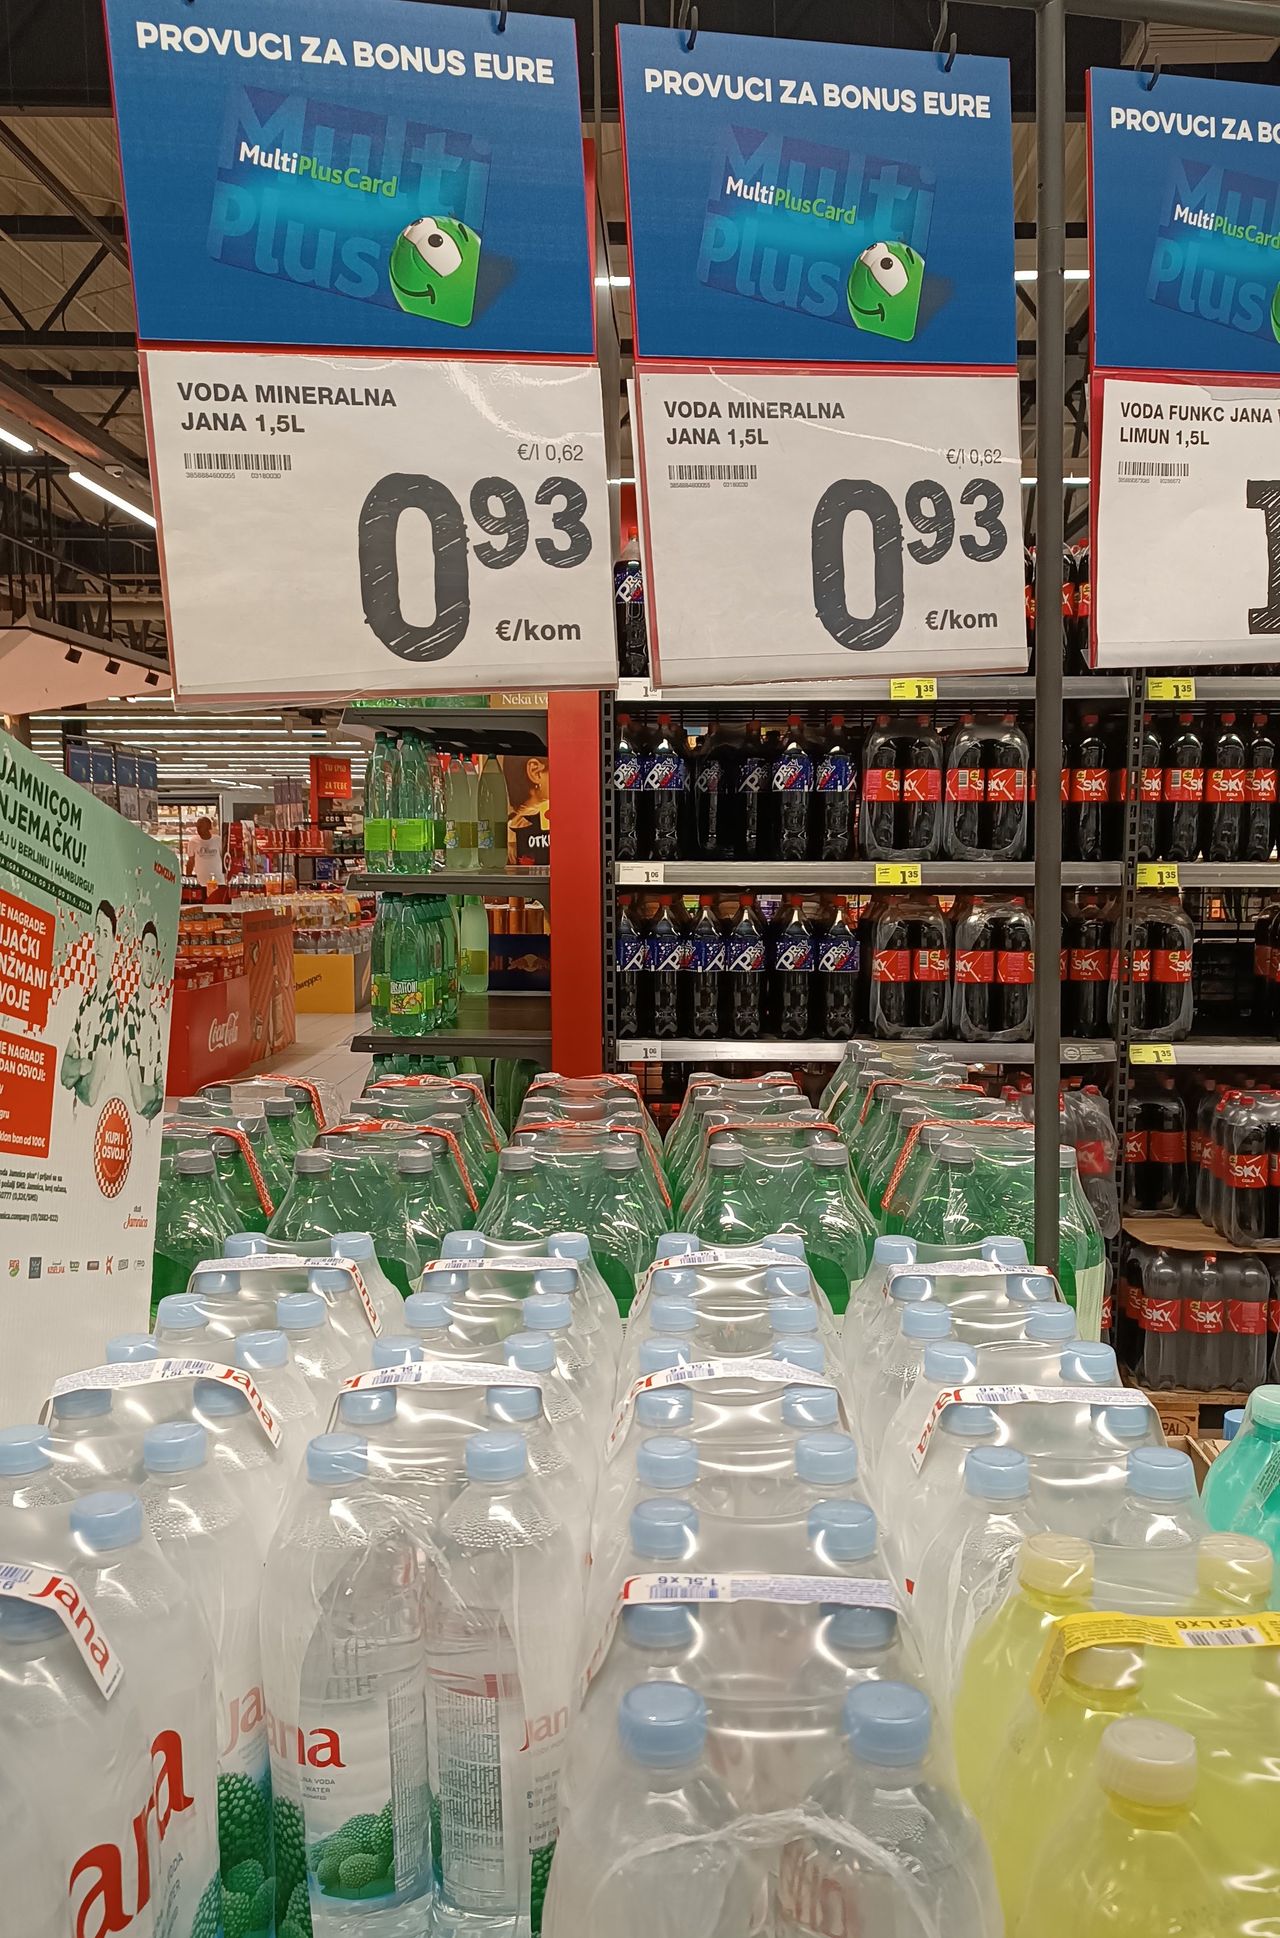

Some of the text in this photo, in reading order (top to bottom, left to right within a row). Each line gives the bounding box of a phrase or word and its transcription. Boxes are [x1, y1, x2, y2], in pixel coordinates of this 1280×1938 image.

[136, 21, 555, 85] PROVUCI ZA BONUS EURE
[644, 68, 991, 119] PROVUCI ZA BONUS EURE
[1111, 107, 1216, 138] PROVUCI
[1222, 118, 1253, 142] ZA
[239, 141, 398, 198] MultiPlusCard
[726, 176, 857, 225] MultiPlusCard
[177, 382, 397, 407] VODA MINERALNA
[664, 401, 845, 419] VODA MINERALNA
[1121, 402, 1273, 423] VODA FUNKC JANA
[181, 412, 305, 436] JANA 1,5L
[667, 428, 769, 448] JANA 1,5L
[1120, 427, 1210, 448] LIMUN 1,5L
[925, 608, 999, 631] €/kom
[495, 618, 582, 644] €/kom
[502, 693, 532, 705] Neka
[1084, 779, 1107, 791] SKY
[1219, 779, 1244, 791] SKY
[1252, 779, 1275, 791] SKY
[1075, 960, 1098, 971] SKY
[1235, 1165, 1261, 1178] SKY
[1145, 1309, 1171, 1322] SKY
[1197, 1310, 1222, 1324] SKY
[28, 1576, 110, 1676] Jana
